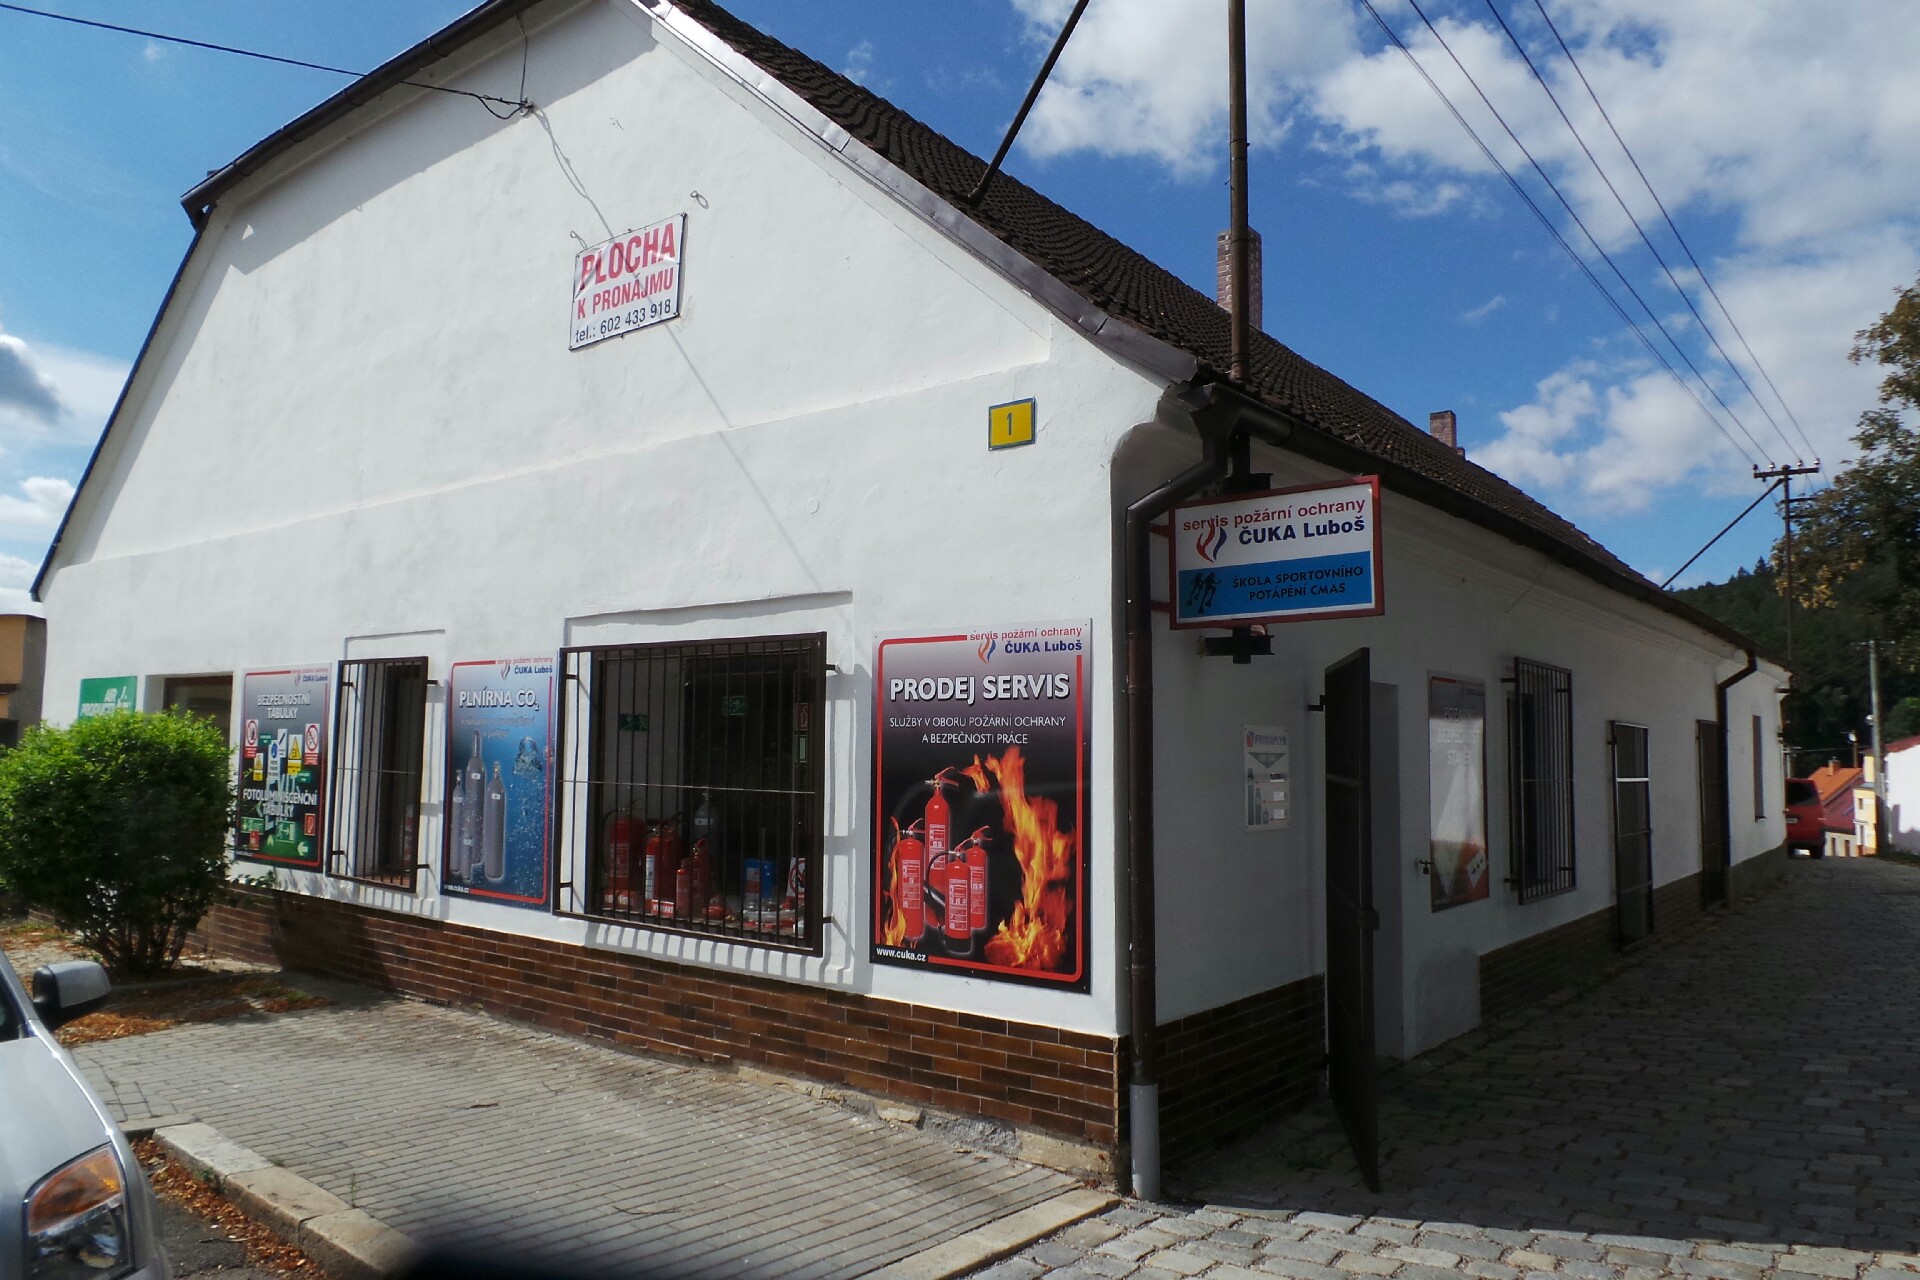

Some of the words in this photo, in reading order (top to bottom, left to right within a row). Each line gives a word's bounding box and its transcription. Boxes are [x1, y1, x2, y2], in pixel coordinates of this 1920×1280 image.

[580, 223, 676, 290] PLOCHA
[577, 298, 586, 320] K
[592, 267, 674, 314] PRONÁJMU
[576, 325, 596, 342] tel.:
[600, 316, 620, 334] 602
[624, 308, 646, 326] 433
[650, 299, 671, 318] 918
[1006, 412, 1013, 435] 1
[1183, 515, 1228, 531] servis
[1234, 505, 1292, 528] požární
[1298, 499, 1366, 516] ochrany
[1238, 524, 1296, 545] ČUKA
[1303, 516, 1365, 537] Luboš
[1233, 575, 1271, 588] ŠKOLA
[1276, 565, 1364, 584] SPORTOVNÍHO
[1249, 584, 1307, 601] POTÁPĚNÍ
[1310, 583, 1345, 595] CMAS
[970, 631, 998, 641] servis
[1001, 629, 1038, 641] požární
[1041, 627, 1082, 638] ochrany
[1004, 641, 1040, 654] ČUKA
[1044, 640, 1082, 652] Luboš
[514, 666, 532, 674] ČUKA
[534, 665, 552, 673] Luboš
[459, 686, 513, 707] PLNÍRNA
[890, 676, 975, 705] PRODEJ
[983, 673, 1070, 700] SERVIS
[267, 708, 298, 719] TABULKY
[890, 715, 922, 727] SLUŽBY
[924, 717, 931, 726] V
[932, 717, 966, 727] OBORU
[969, 714, 1012, 727] POŽÁRNÍ
[1014, 716, 1066, 727] OCHRANY
[922, 734, 928, 744] A
[930, 732, 994, 744] BEZPEČNOSTI
[997, 731, 1028, 744] PRÁCE
[262, 803, 294, 817] TABULKY
[876, 948, 926, 962] www.cuka.cz
